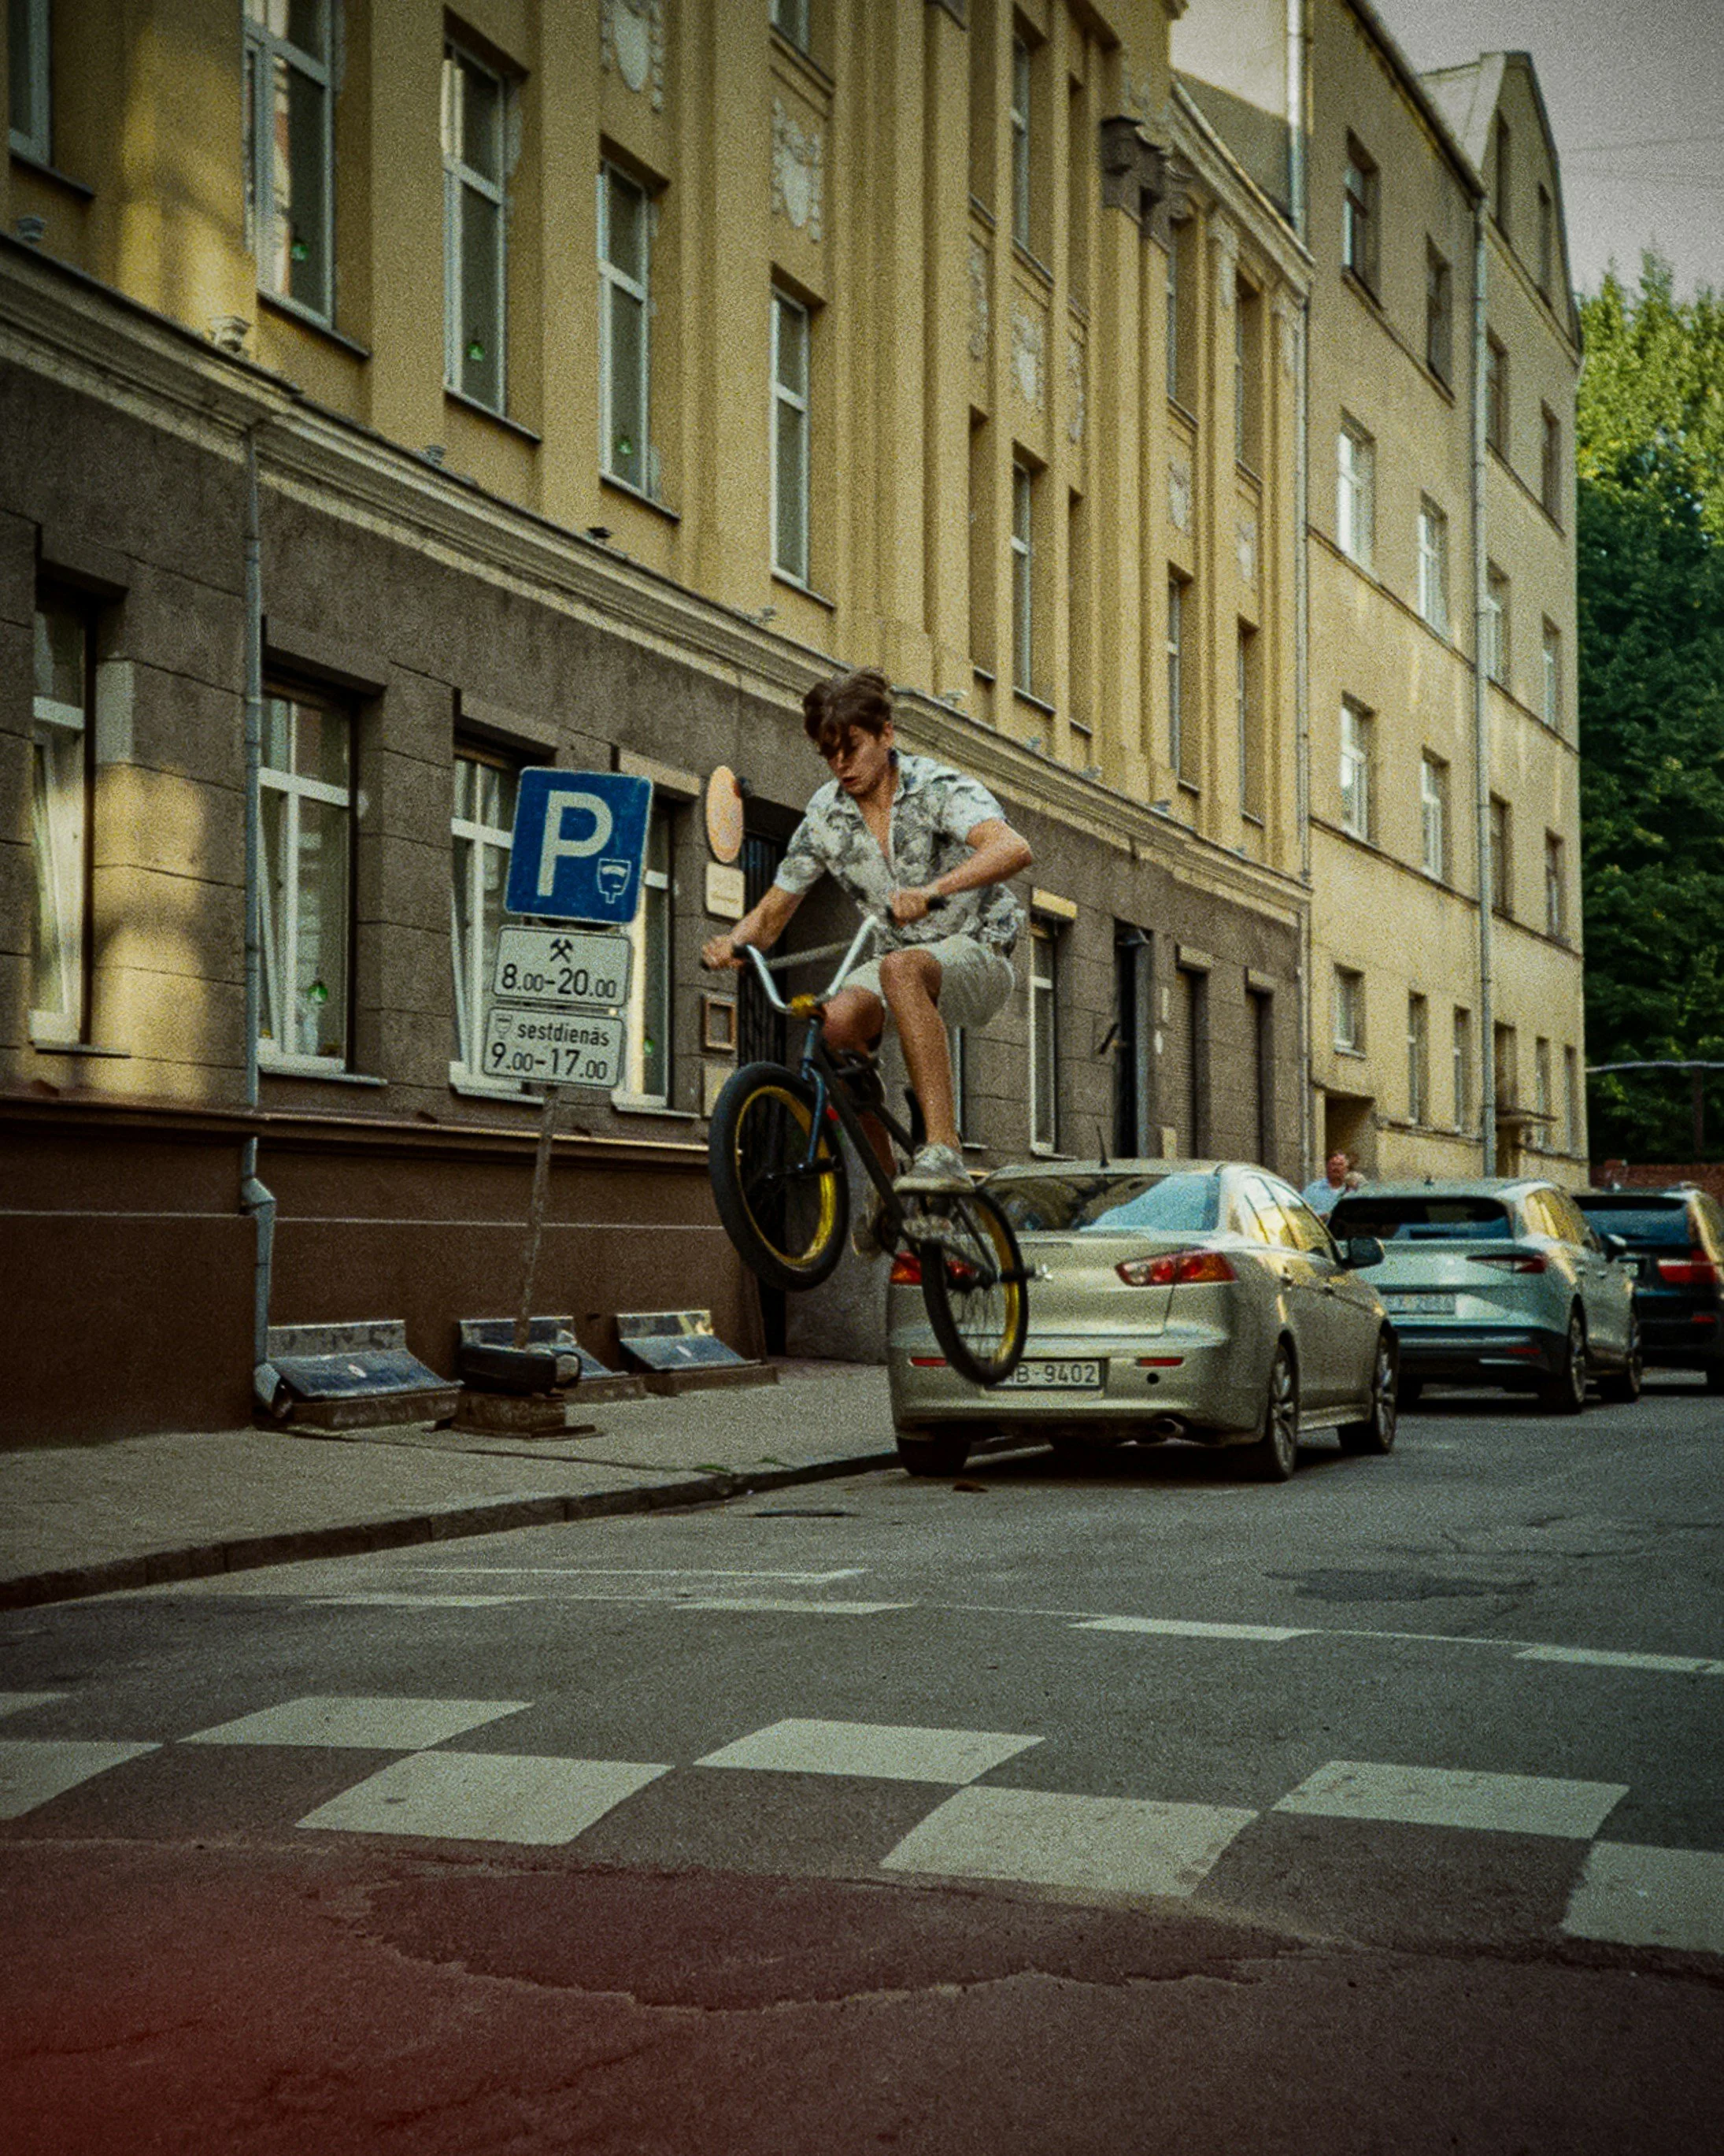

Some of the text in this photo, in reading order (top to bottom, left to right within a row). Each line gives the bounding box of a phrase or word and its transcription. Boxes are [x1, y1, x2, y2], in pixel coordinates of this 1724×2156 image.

[537, 790, 613, 897] P
[501, 963, 616, 998] 8.00-20.00
[517, 1022, 610, 1047] sestdienās
[491, 1041, 608, 1080] 9.00-17.00
[1008, 1364, 1096, 1384] B-9402
